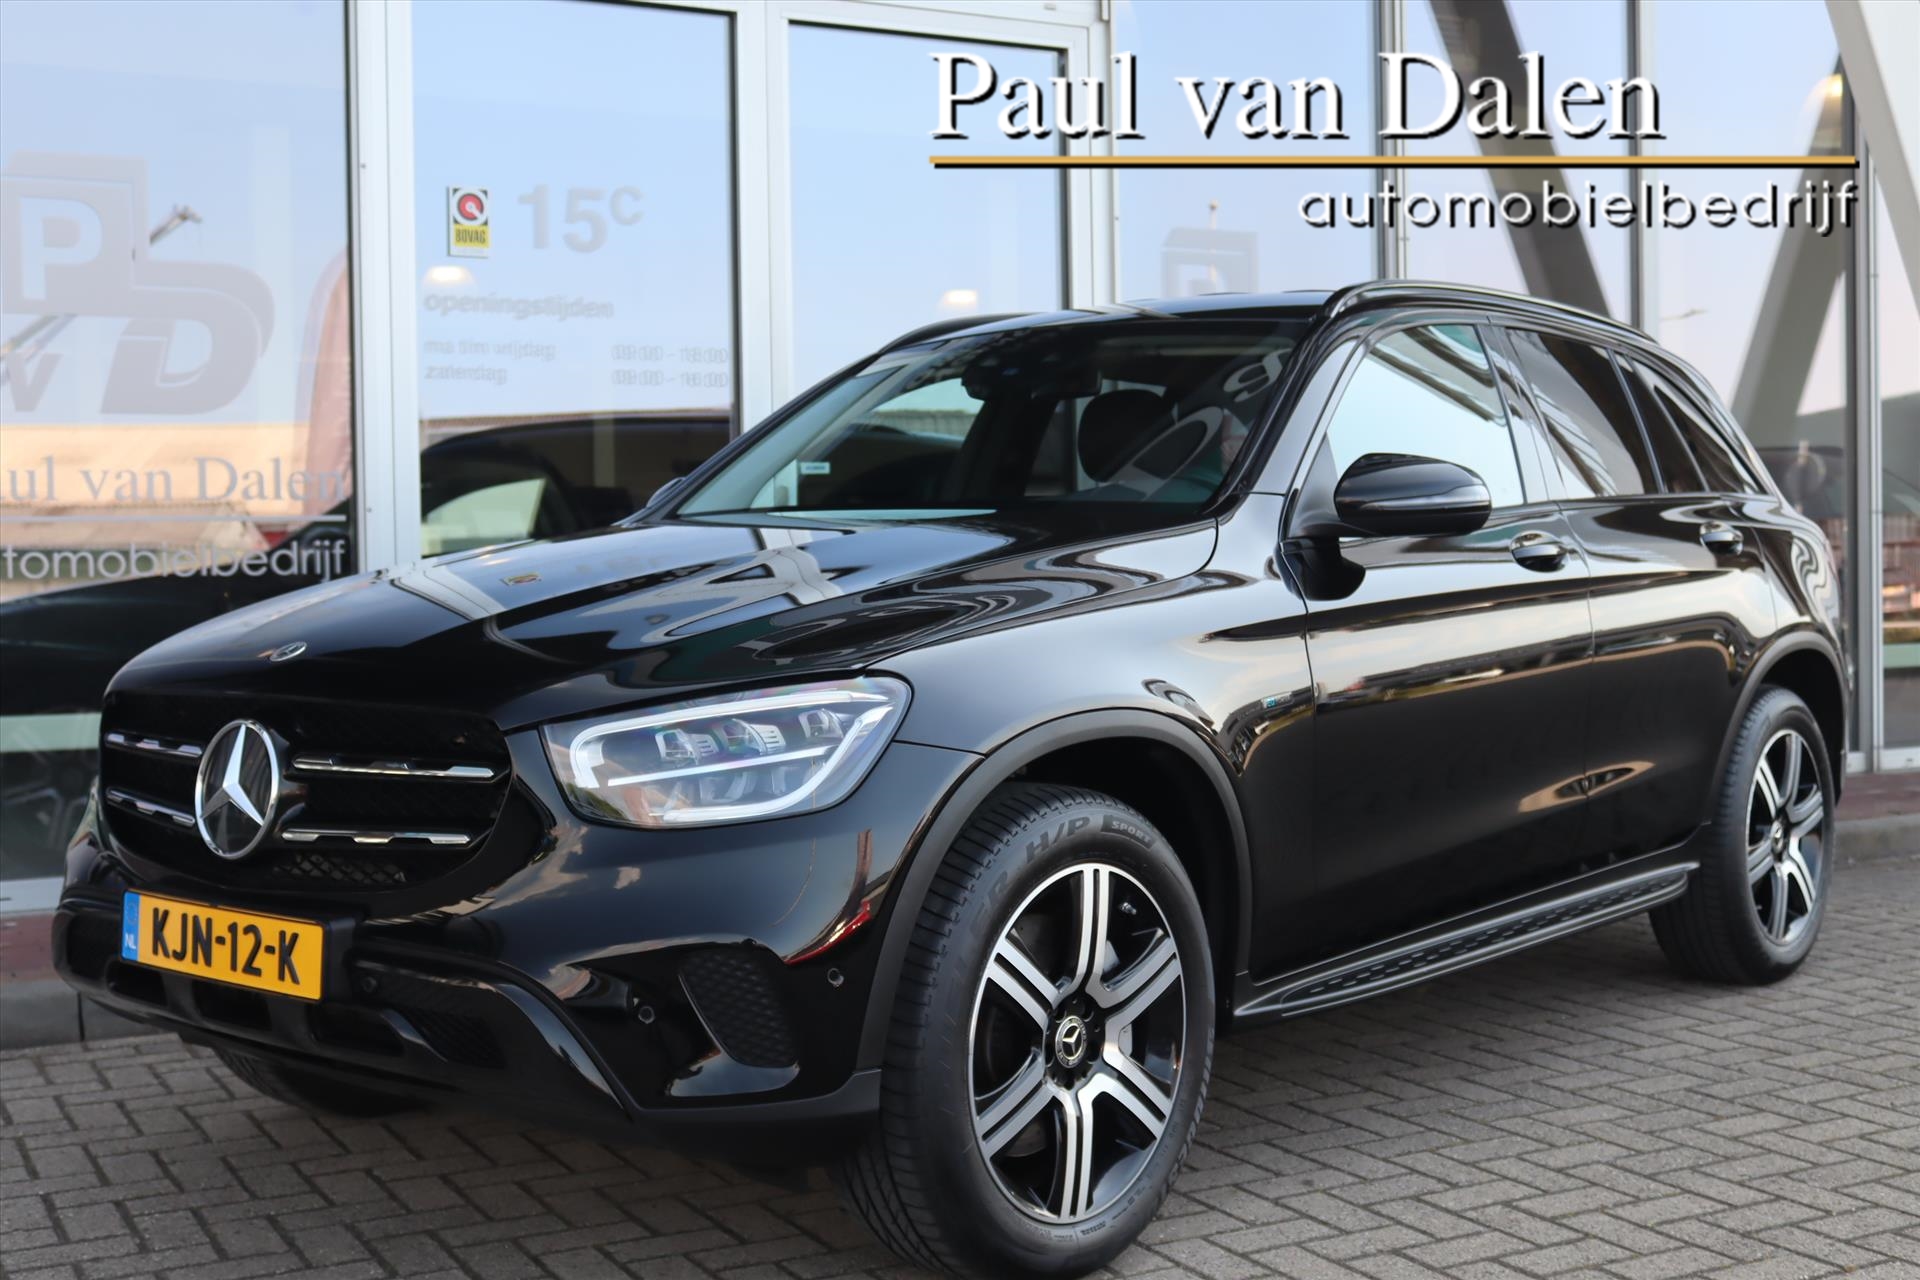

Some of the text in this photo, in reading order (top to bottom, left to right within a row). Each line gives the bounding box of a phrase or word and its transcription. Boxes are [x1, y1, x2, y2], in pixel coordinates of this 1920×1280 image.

[455, 227, 486, 245] BOVAG
[423, 293, 614, 320] openingstijden
[0, 455, 345, 501] ul van Dalen
[1025, 816, 1090, 864] H/P
[1111, 820, 1152, 844] SPORT
[124, 933, 137, 950] NL
[152, 907, 300, 985] KJN-12-K
